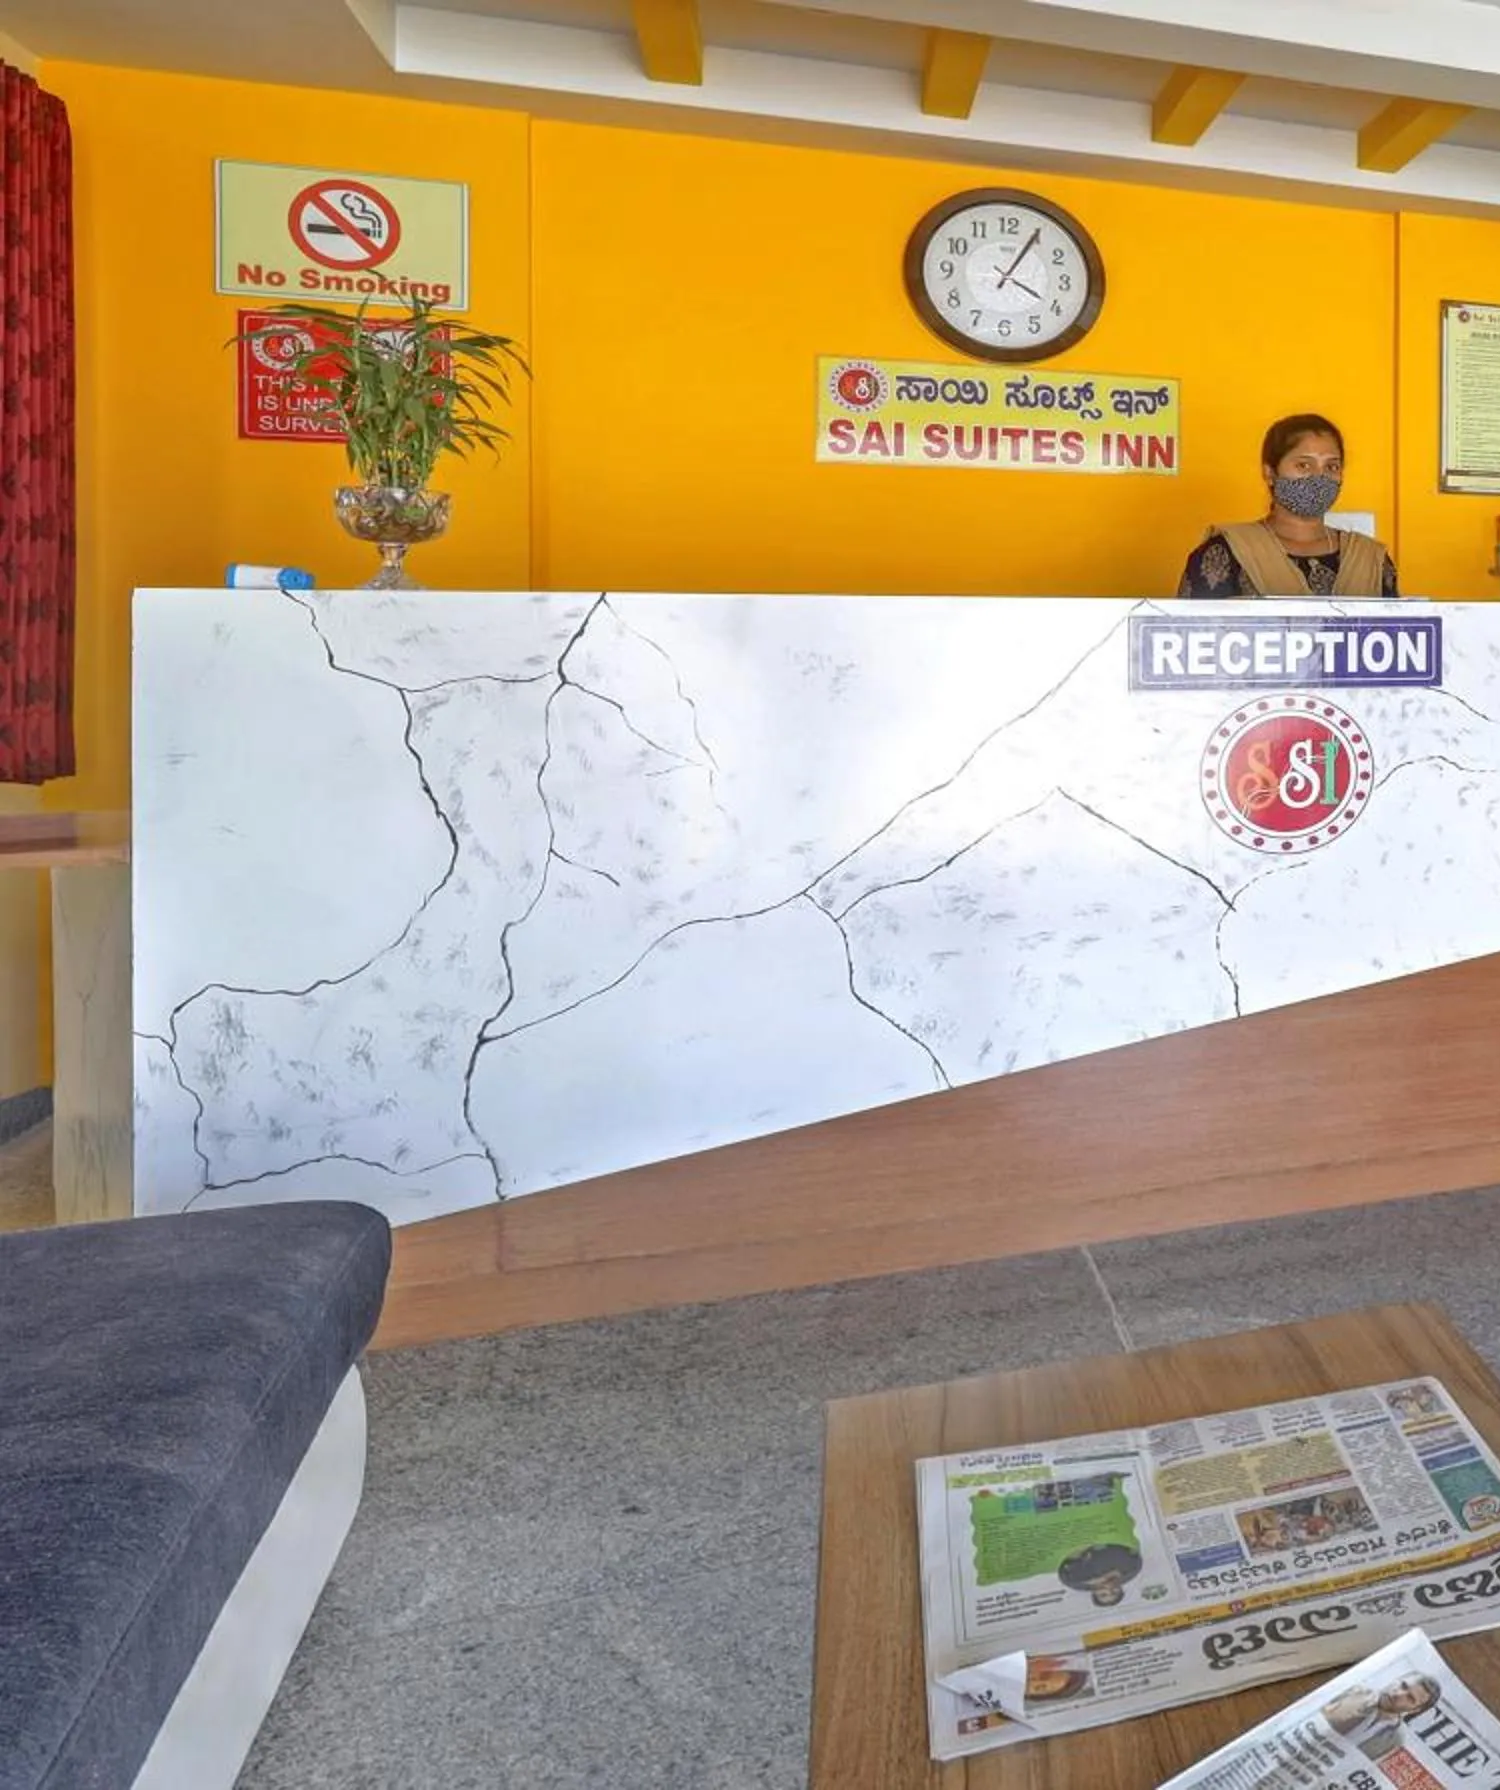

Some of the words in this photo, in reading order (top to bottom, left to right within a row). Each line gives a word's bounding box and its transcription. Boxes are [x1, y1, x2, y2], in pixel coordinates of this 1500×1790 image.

[971, 220, 987, 239] 11
[998, 216, 1020, 235] 12
[948, 237, 968, 256] 10
[1052, 248, 1065, 266] 2
[940, 261, 954, 280] 9
[237, 263, 287, 287] No
[299, 268, 451, 303] Smoking
[1058, 274, 1071, 292] 3
[947, 290, 961, 310] 8
[1050, 299, 1062, 317] 4
[969, 310, 982, 328] 7
[998, 319, 1012, 337] 6
[1028, 315, 1041, 334] 5
[256, 394, 280, 411] IS
[895, 374, 990, 406] ಸಾಯಿ
[1110, 386, 1170, 418] ಇನ್
[827, 418, 905, 457] SAI
[922, 422, 1086, 466] SUITES
[1101, 433, 1175, 469] INN
[1150, 631, 1428, 675] RECEPTION
